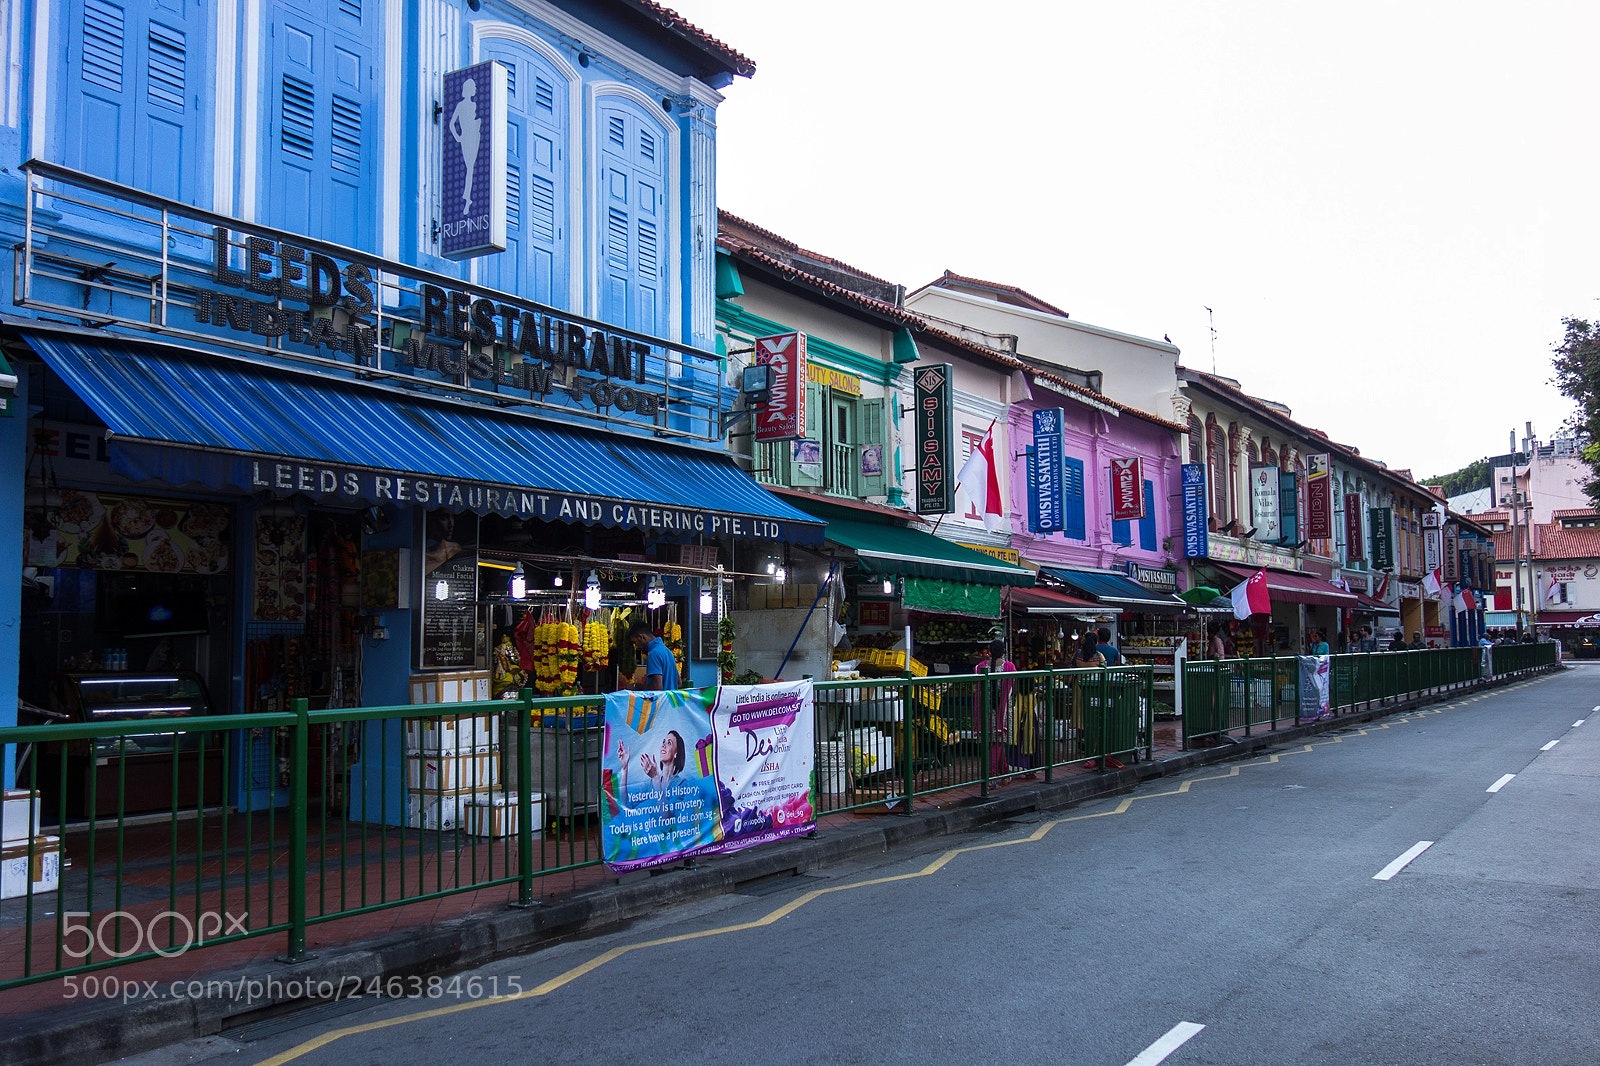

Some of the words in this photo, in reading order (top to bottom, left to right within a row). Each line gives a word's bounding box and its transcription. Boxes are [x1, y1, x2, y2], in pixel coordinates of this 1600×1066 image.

[213, 226, 374, 317] LEEDS
[420, 283, 651, 385] RESTAURANT
[195, 290, 375, 358] INDIAN
[403, 337, 553, 394] MUSLIM
[760, 335, 796, 424] VANESSA
[829, 371, 854, 392] SALON
[757, 425, 778, 433] Beauty
[779, 422, 796, 430] Salon
[1038, 437, 1053, 529] OMSIVASAKTHI
[1115, 459, 1136, 509] VANESSA
[1254, 487, 1276, 496] Komala
[253, 461, 360, 496] LEEDS
[375, 476, 550, 515] RESTAURANT
[559, 498, 603, 522] AND
[612, 503, 704, 531] CATERING
[711, 514, 746, 536] PTE.
[753, 519, 780, 539] LTD
[1258, 498, 1272, 507] Vilas
[1311, 483, 1324, 529] Nalli
[1186, 486, 1198, 557] OMSIVASAKTHI
[736, 695, 750, 704] Little
[750, 692, 765, 703] India
[732, 714, 742, 723] GO
[742, 712, 750, 721] TO
[628, 788, 664, 803] Yesterday
[665, 788, 671, 797] is
[625, 805, 661, 818] Tomorrow
[662, 802, 669, 812] is
[670, 803, 674, 811] a
[610, 823, 633, 836] Today
[633, 821, 639, 831] is
[644, 816, 657, 832] gift
[658, 813, 676, 827] from
[677, 811, 713, 824] dei.com.sg
[631, 834, 648, 848] Here
[649, 830, 665, 844] have
[672, 824, 701, 842] present!
